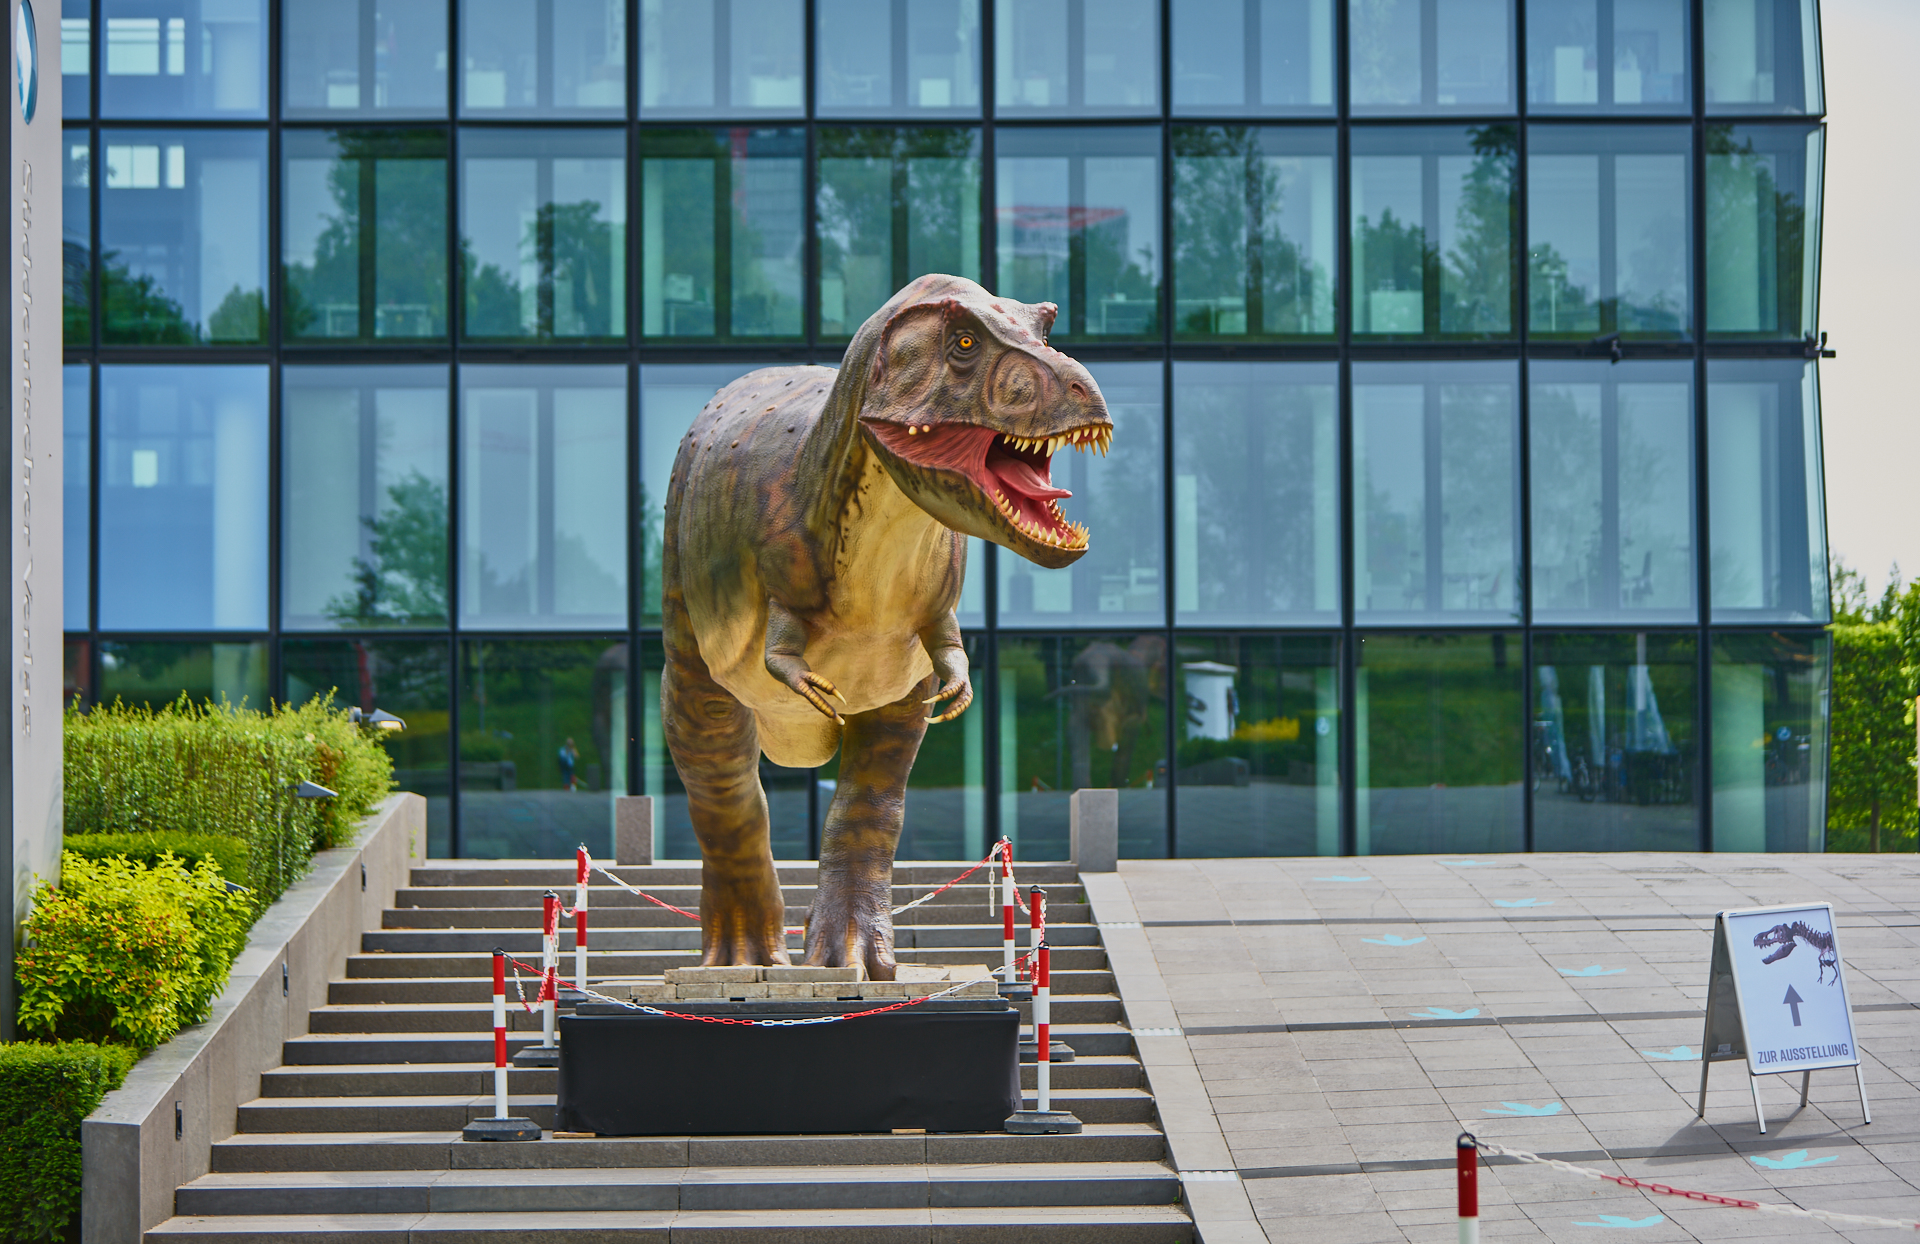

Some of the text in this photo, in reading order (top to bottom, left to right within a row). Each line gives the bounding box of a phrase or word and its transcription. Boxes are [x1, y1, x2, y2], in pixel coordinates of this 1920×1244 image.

[22, 159, 34, 740] Süddeutscher Verlag
[1757, 1050, 1778, 1064] ZUR
[1780, 1043, 1849, 1062] AUSSTELLUNG
